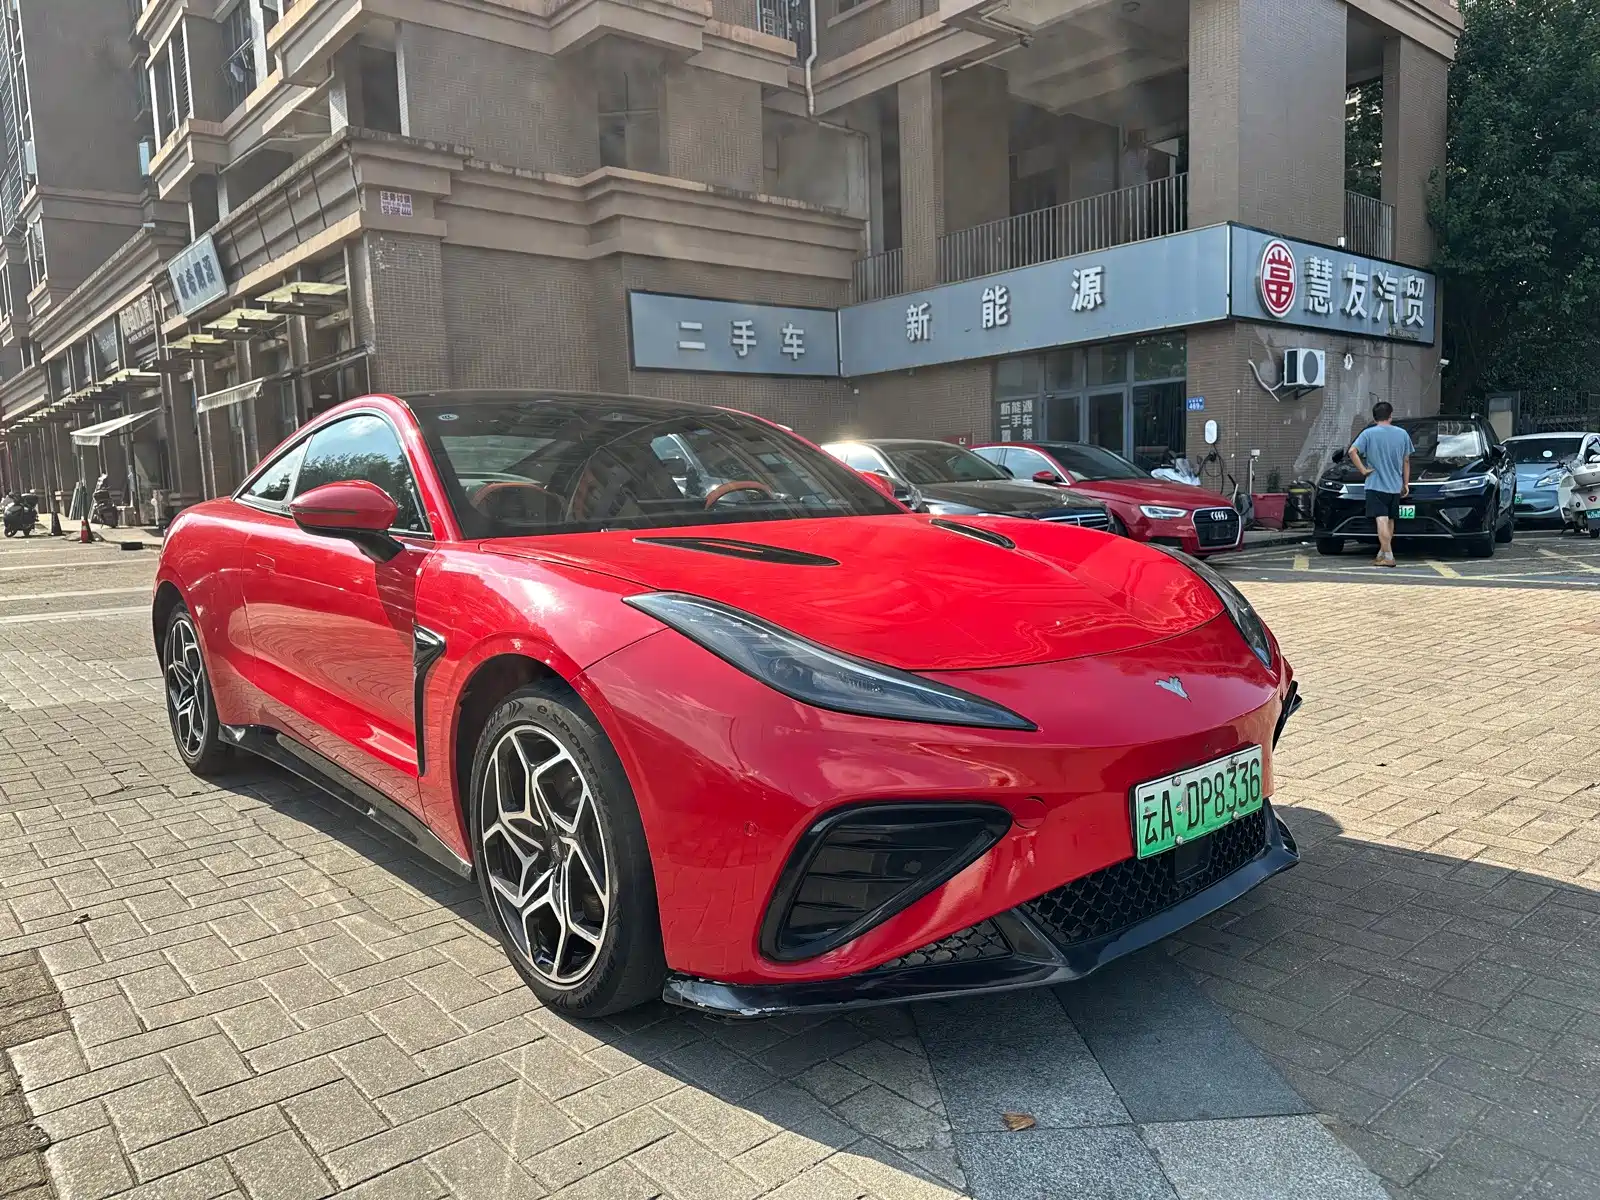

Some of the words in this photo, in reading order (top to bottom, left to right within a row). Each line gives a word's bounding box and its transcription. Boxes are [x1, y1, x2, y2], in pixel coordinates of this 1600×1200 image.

[906, 266, 1103, 341] 新能源
[1306, 256, 1426, 328] 慧友汽贸
[678, 320, 805, 360] 二手车
[1000, 400, 1033, 415] 新能源
[1000, 414, 1033, 429] 二手车
